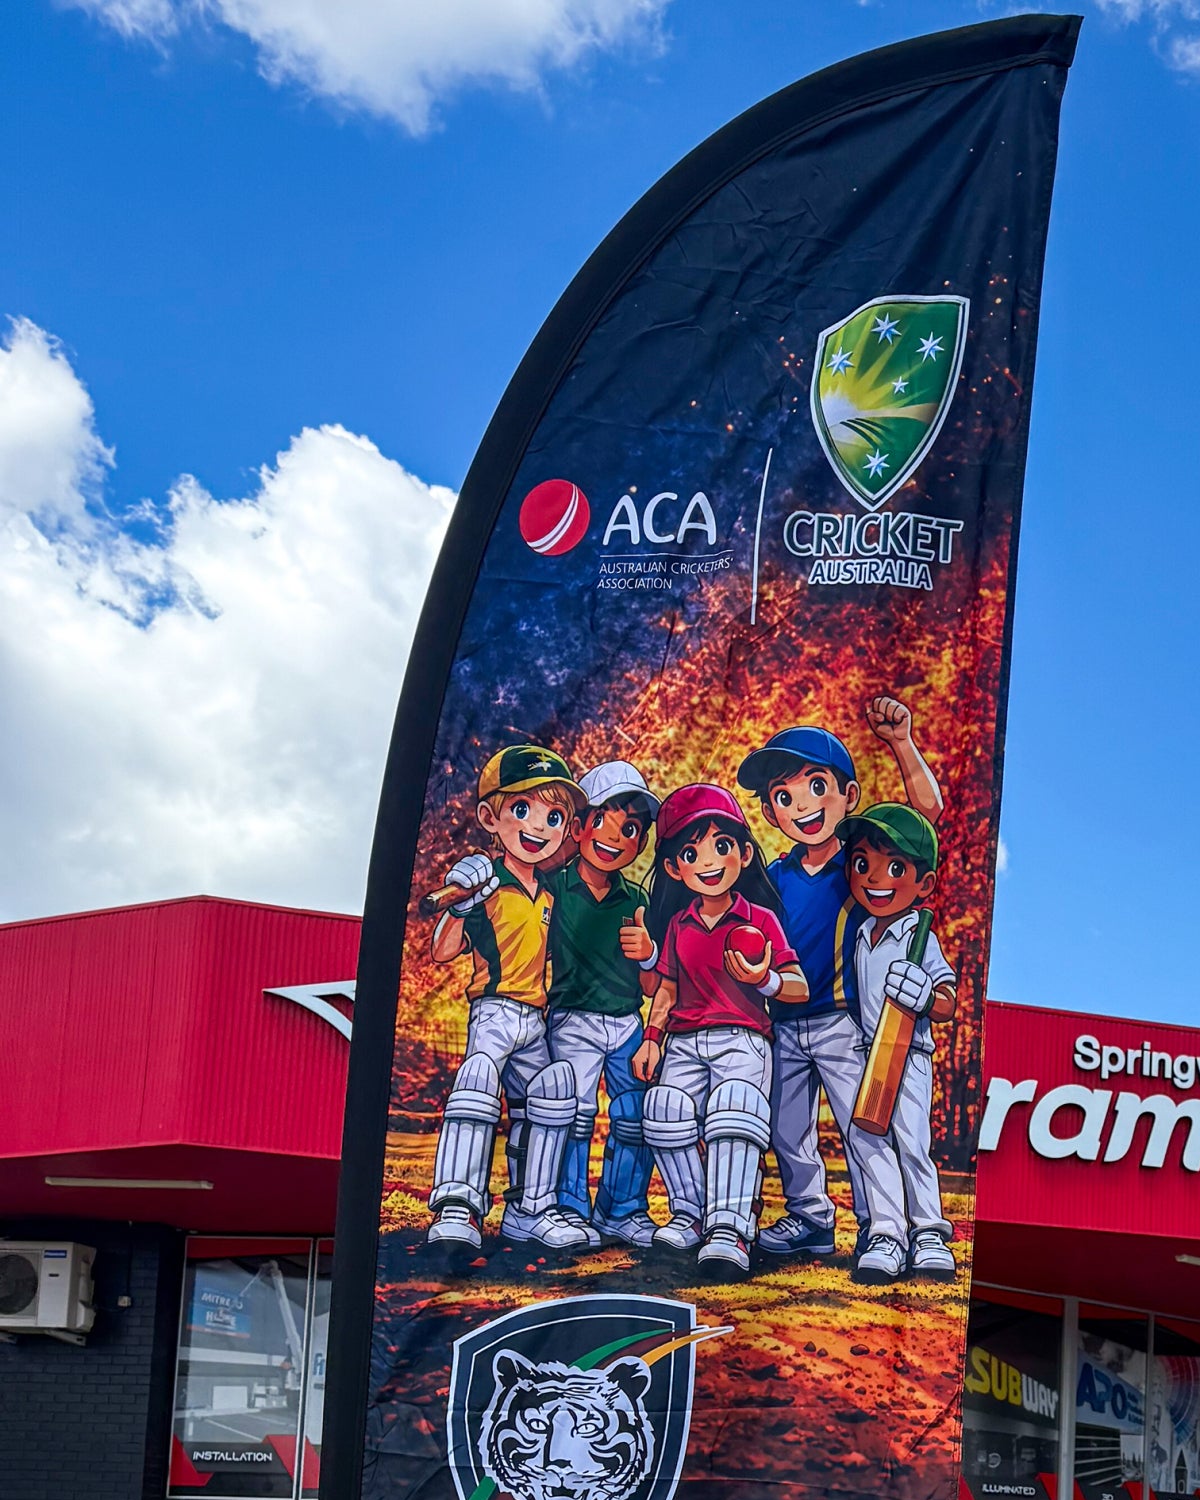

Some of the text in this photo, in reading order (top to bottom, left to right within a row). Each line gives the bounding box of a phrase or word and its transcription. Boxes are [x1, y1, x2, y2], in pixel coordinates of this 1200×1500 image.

[602, 491, 717, 546] ACA
[783, 510, 964, 564] CRICKET
[599, 561, 668, 574] AUSTRALIAN
[807, 557, 934, 591] AUSTRALIA
[596, 577, 672, 590] ASSOCIATION
[964, 1345, 1059, 1420] SUBWAY
[192, 1450, 273, 1463] INSTALLATION
[982, 1483, 1036, 1497] ILLUMINATED
